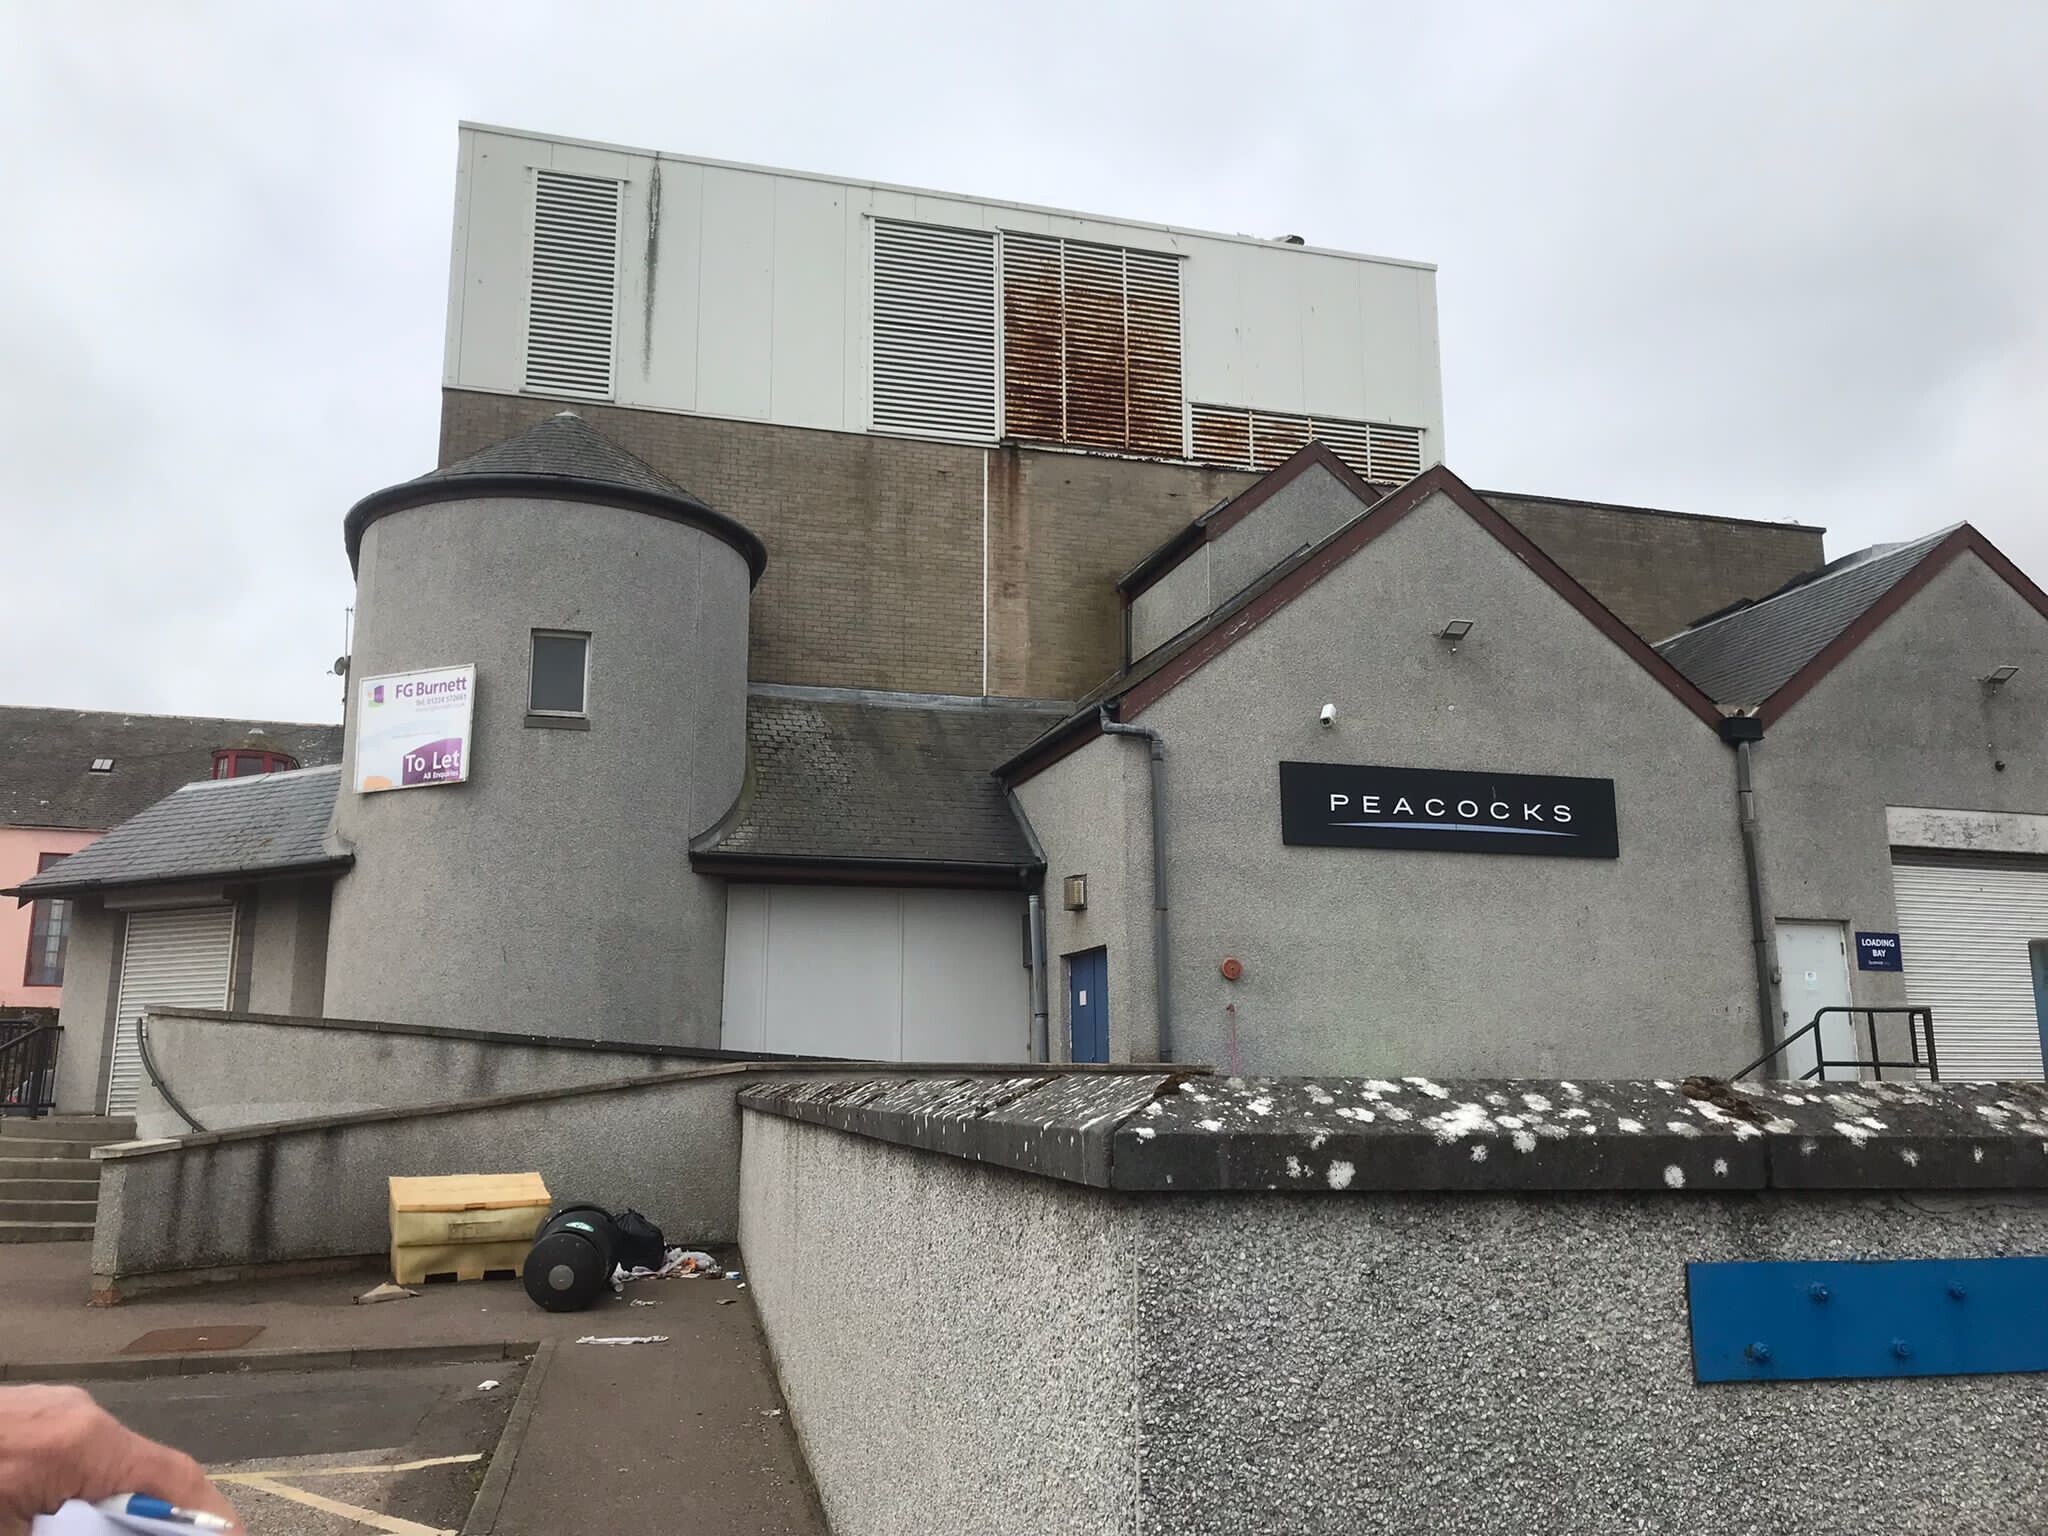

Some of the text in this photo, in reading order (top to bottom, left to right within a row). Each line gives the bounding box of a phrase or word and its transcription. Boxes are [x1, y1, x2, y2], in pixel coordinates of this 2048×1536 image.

[396, 677, 467, 699] FG Burnett
[405, 750, 460, 773] To Let
[1330, 794, 1572, 823] PEACOCKS
[1861, 938, 1895, 947] LOADING
[1872, 949, 1886, 957] BAY
